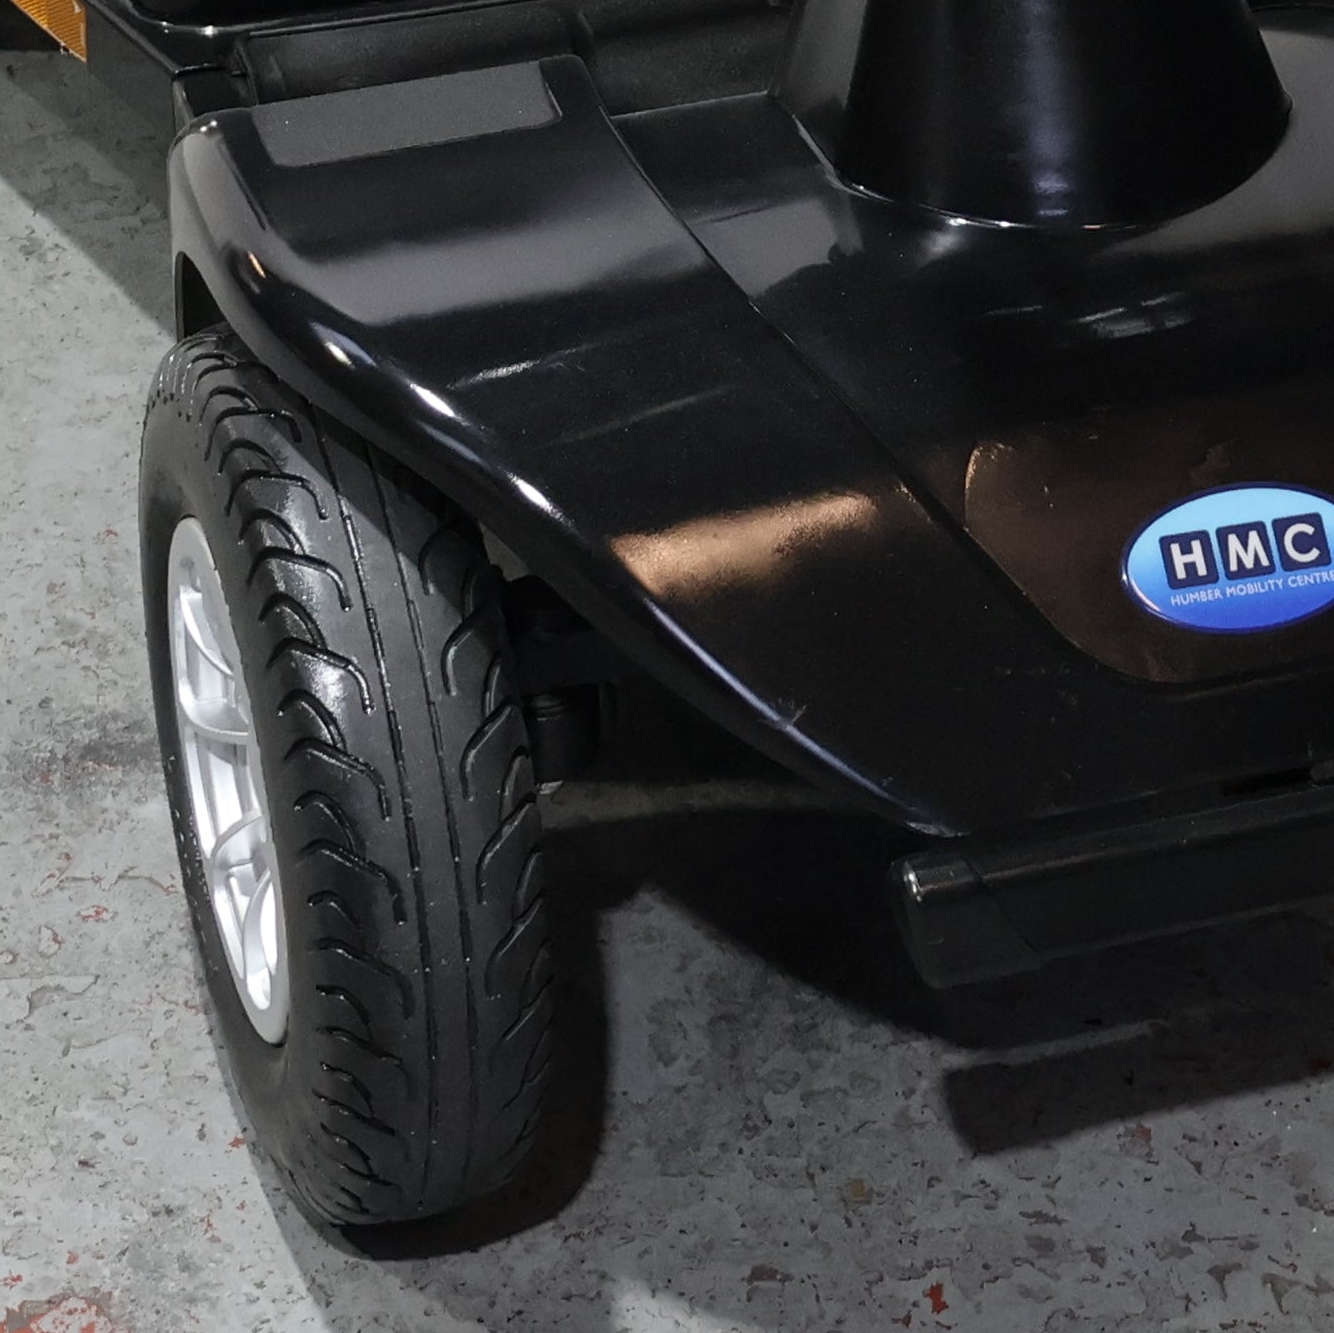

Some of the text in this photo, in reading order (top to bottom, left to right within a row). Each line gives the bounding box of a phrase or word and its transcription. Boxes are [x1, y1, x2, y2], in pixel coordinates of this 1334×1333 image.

[1170, 523, 1320, 580] HMC
[1170, 589, 1222, 606] HUMBER
[1225, 579, 1283, 597] MOBILITY
